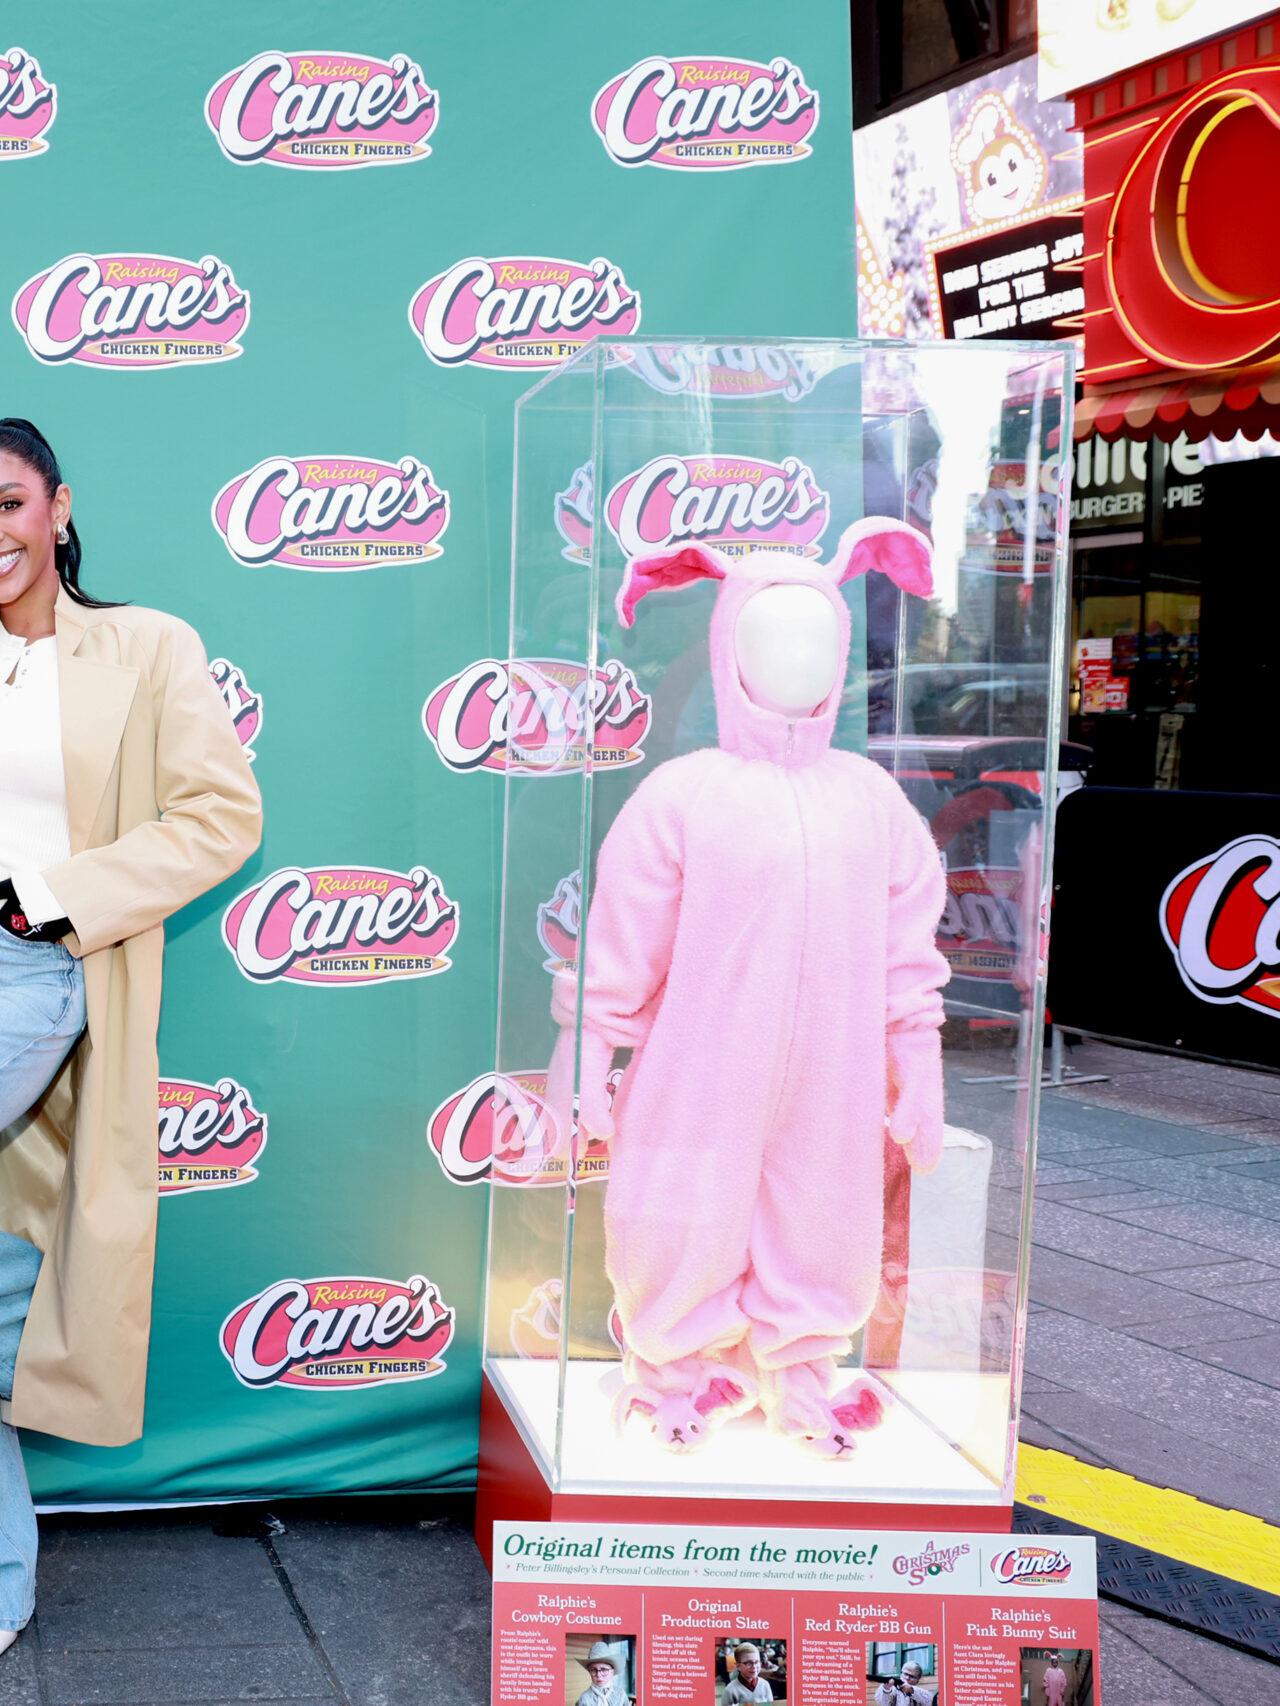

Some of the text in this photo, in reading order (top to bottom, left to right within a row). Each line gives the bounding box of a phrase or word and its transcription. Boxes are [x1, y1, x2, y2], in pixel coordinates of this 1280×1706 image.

[296, 59, 368, 81] Raising
[679, 64, 750, 85] Raising
[220, 52, 433, 159] Cane's
[605, 57, 813, 161] Cane's
[291, 142, 410, 156] CHICKEN FINGERS
[675, 144, 791, 158] CHICKEN FINGERS
[105, 261, 179, 283] Raising
[499, 263, 571, 285] Raising
[27, 254, 244, 359] Cane's
[424, 256, 635, 361] Cane's
[100, 342, 222, 356] CHICKEN FINGERS
[495, 344, 552, 357] CHICKEN
[304, 462, 378, 484] Raising
[692, 462, 763, 483] Raising
[226, 455, 443, 560] Cane's
[619, 455, 825, 556] Cane's
[299, 544, 421, 558] CHICKEN FINGERS
[437, 659, 645, 766] Cane's
[315, 872, 389, 895] Raising
[238, 865, 453, 975] Cane's
[310, 958, 431, 972] CHICKEN FINGERS
[158, 1082, 263, 1158] ne's
[178, 1168, 238, 1180] FINGERS
[312, 1284, 383, 1305] Raising
[238, 1278, 446, 1378] Cane's
[308, 1362, 424, 1375] CHICKEN FINGERS
[504, 1533, 878, 1565] Original items from the movie!
[925, 1540, 934, 1552] A
[1021, 1548, 1048, 1557] Raising
[515, 1562, 690, 1577] Peter Billingsley's Personal Collection
[892, 1543, 971, 1575] CHRISTMAS
[994, 1546, 1071, 1583] Cane's
[703, 1568, 865, 1583] Second time shared with the public
[538, 1594, 597, 1609] Ralphie's
[688, 1599, 742, 1614] Original
[838, 1603, 898, 1617] Ralphie's
[511, 1610, 622, 1626] Cowboy Costume
[661, 1614, 770, 1630] Production Slate
[991, 1608, 1051, 1622] Ralphie's
[805, 1618, 932, 1635] Red Ryder BB Gun
[966, 1624, 1077, 1640] Pink Bunny Suit
